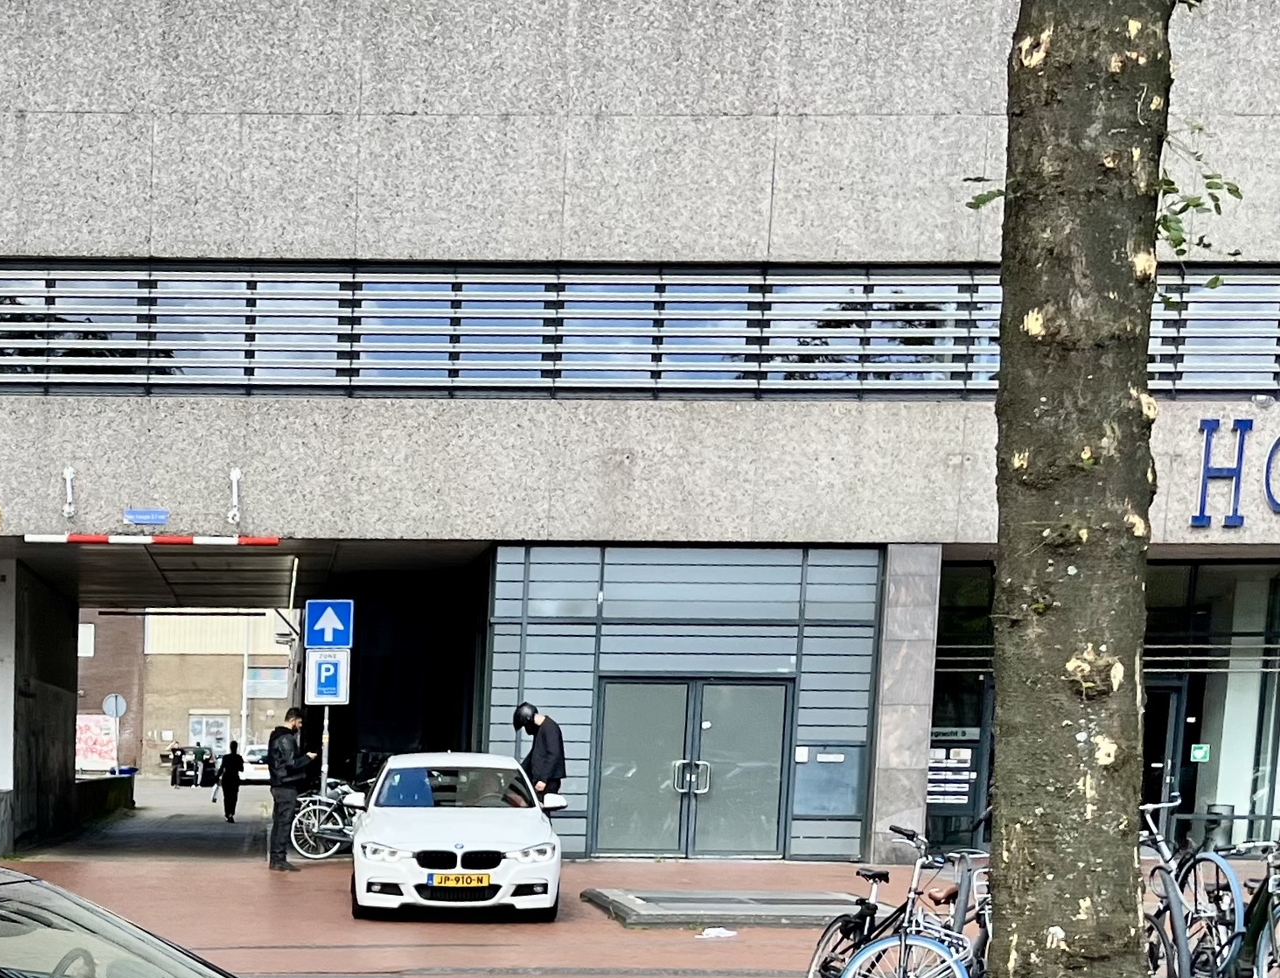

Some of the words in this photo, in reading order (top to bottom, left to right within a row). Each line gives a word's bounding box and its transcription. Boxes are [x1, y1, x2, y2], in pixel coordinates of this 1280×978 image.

[1190, 418, 1280, 528] H
[320, 664, 335, 683] P
[437, 876, 484, 885] JP-910-N
